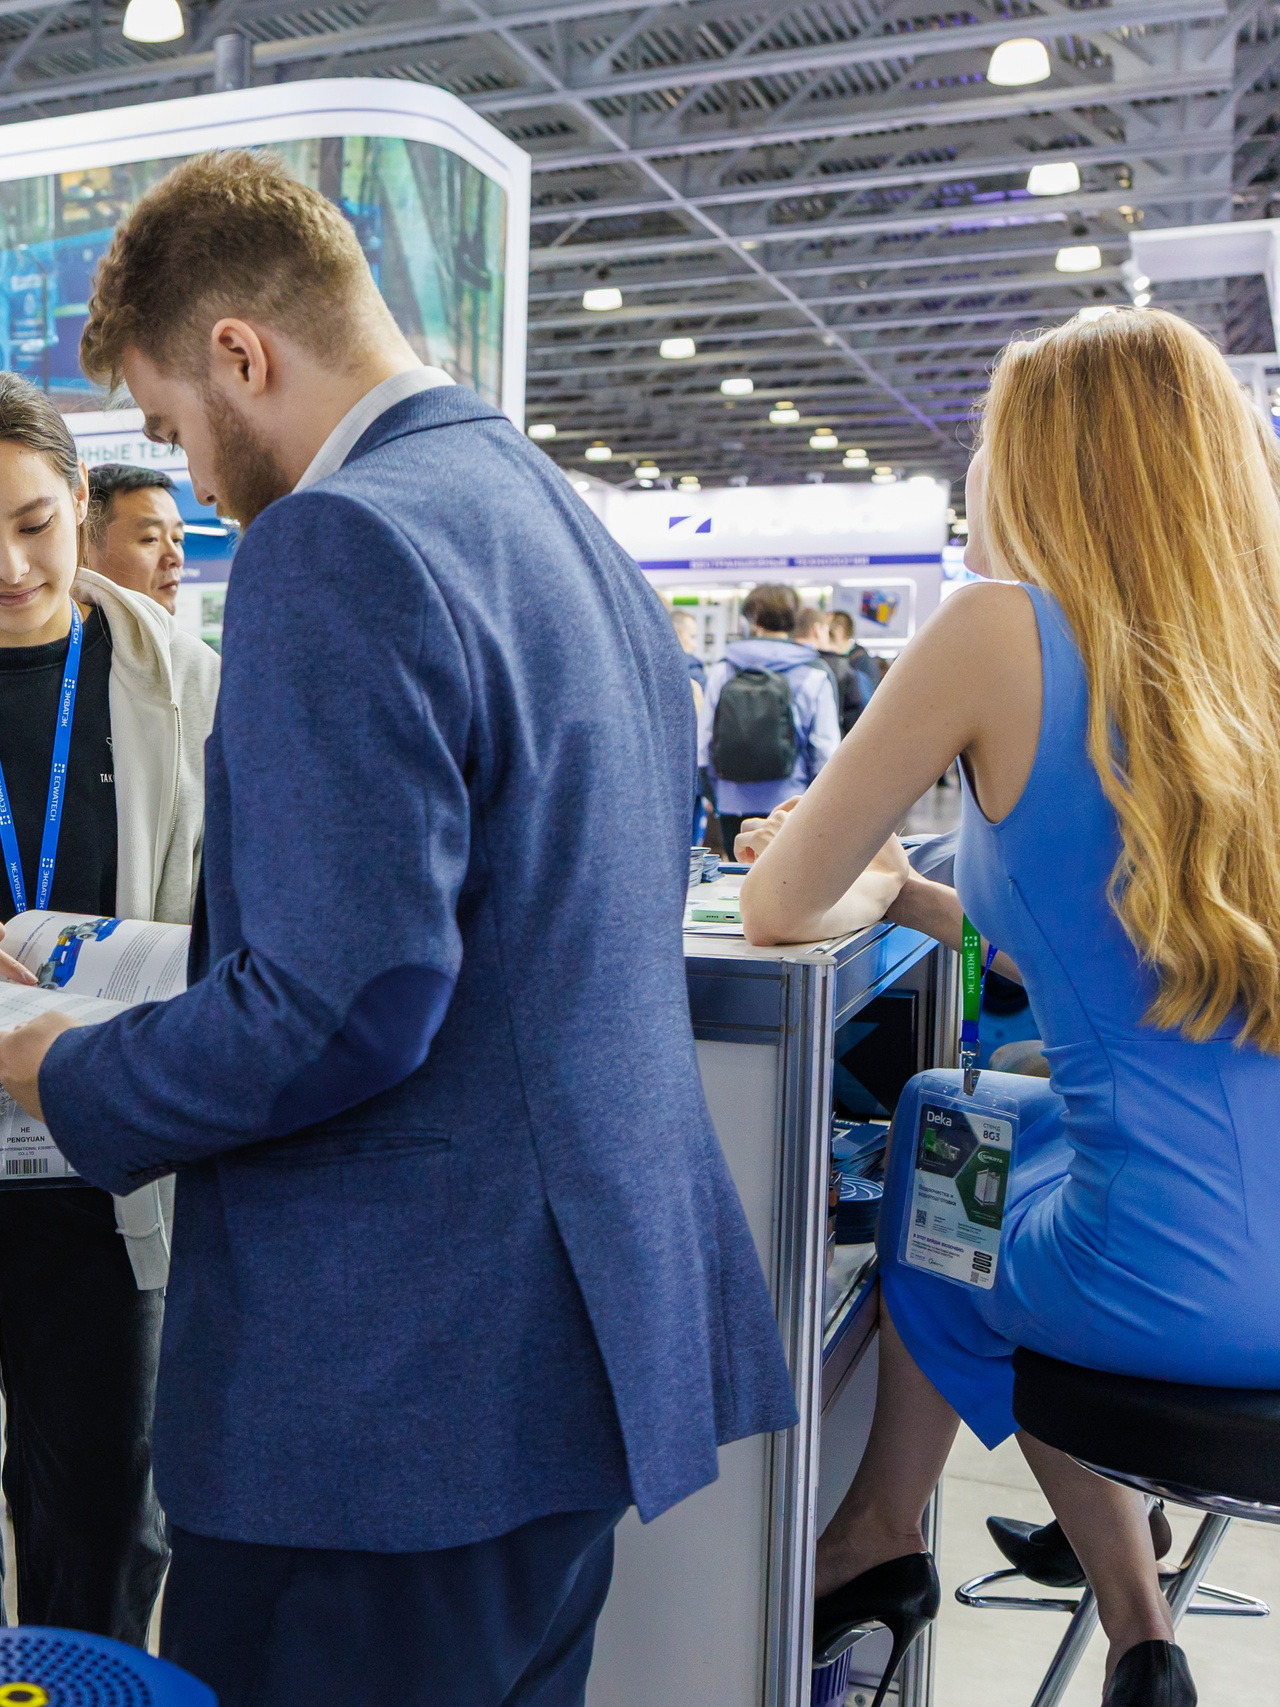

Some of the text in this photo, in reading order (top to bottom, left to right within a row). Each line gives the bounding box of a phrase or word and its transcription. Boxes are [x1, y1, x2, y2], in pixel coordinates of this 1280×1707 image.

[77, 444, 131, 462] ННЫЕ
[99, 773, 115, 783] TAK
[49, 775, 62, 822] ECWATECH
[926, 1111, 952, 1127] Deka
[6, 1136, 45, 1144] PENGYUAN
[982, 1130, 1000, 1142] 8G3
